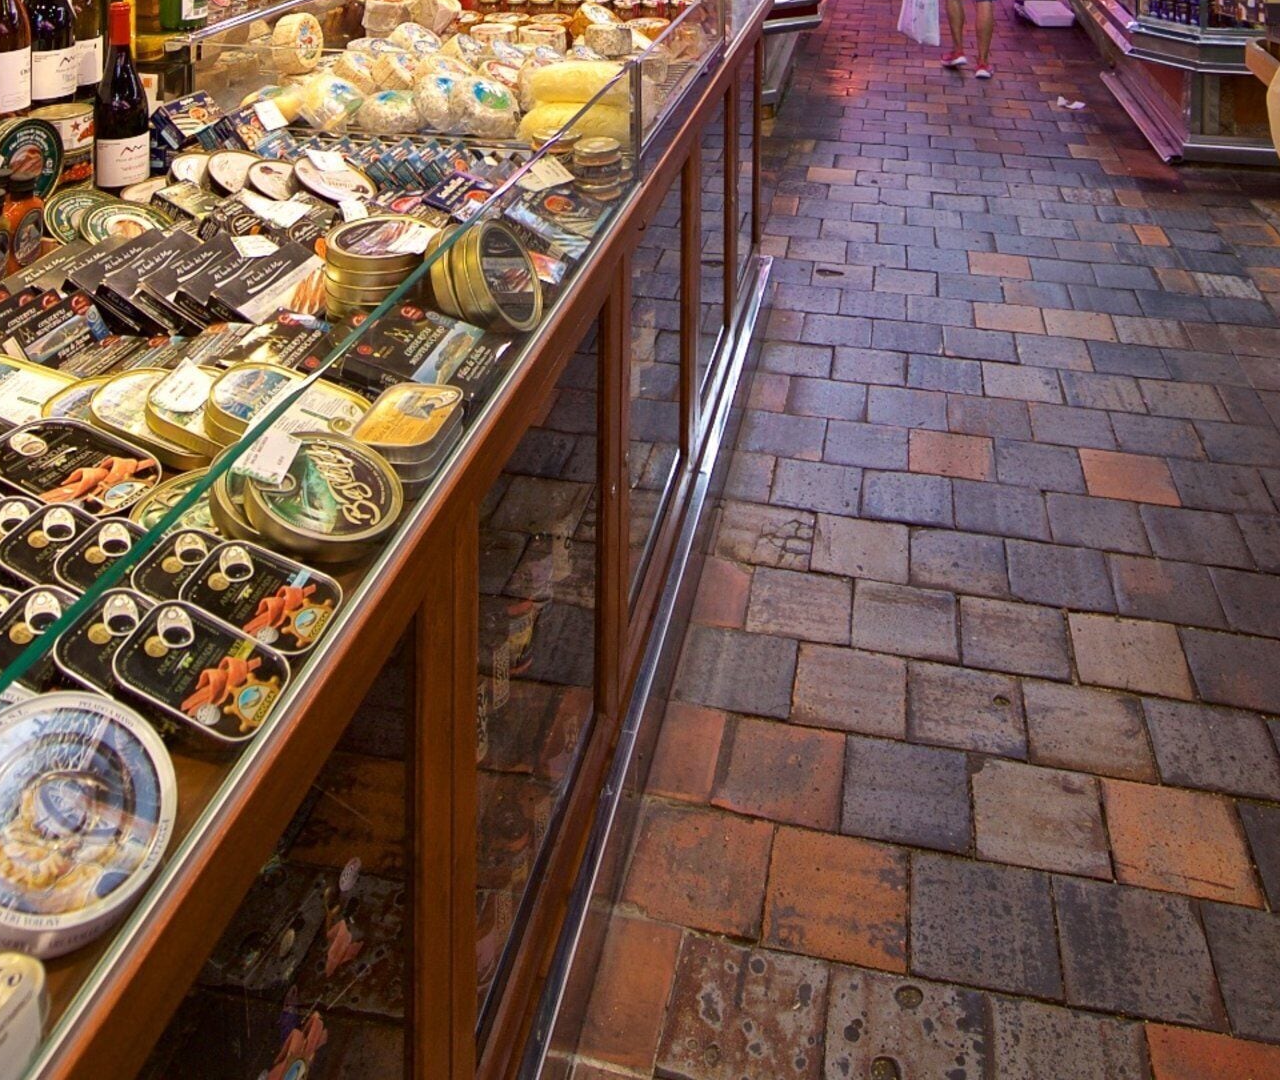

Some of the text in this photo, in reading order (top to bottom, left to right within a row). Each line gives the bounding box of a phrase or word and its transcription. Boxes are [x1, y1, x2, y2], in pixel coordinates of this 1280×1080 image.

[26, 443, 70, 471] ANCHOAS
[77, 700, 135, 728] PELADO MANO
[255, 689, 277, 722] CODESA
